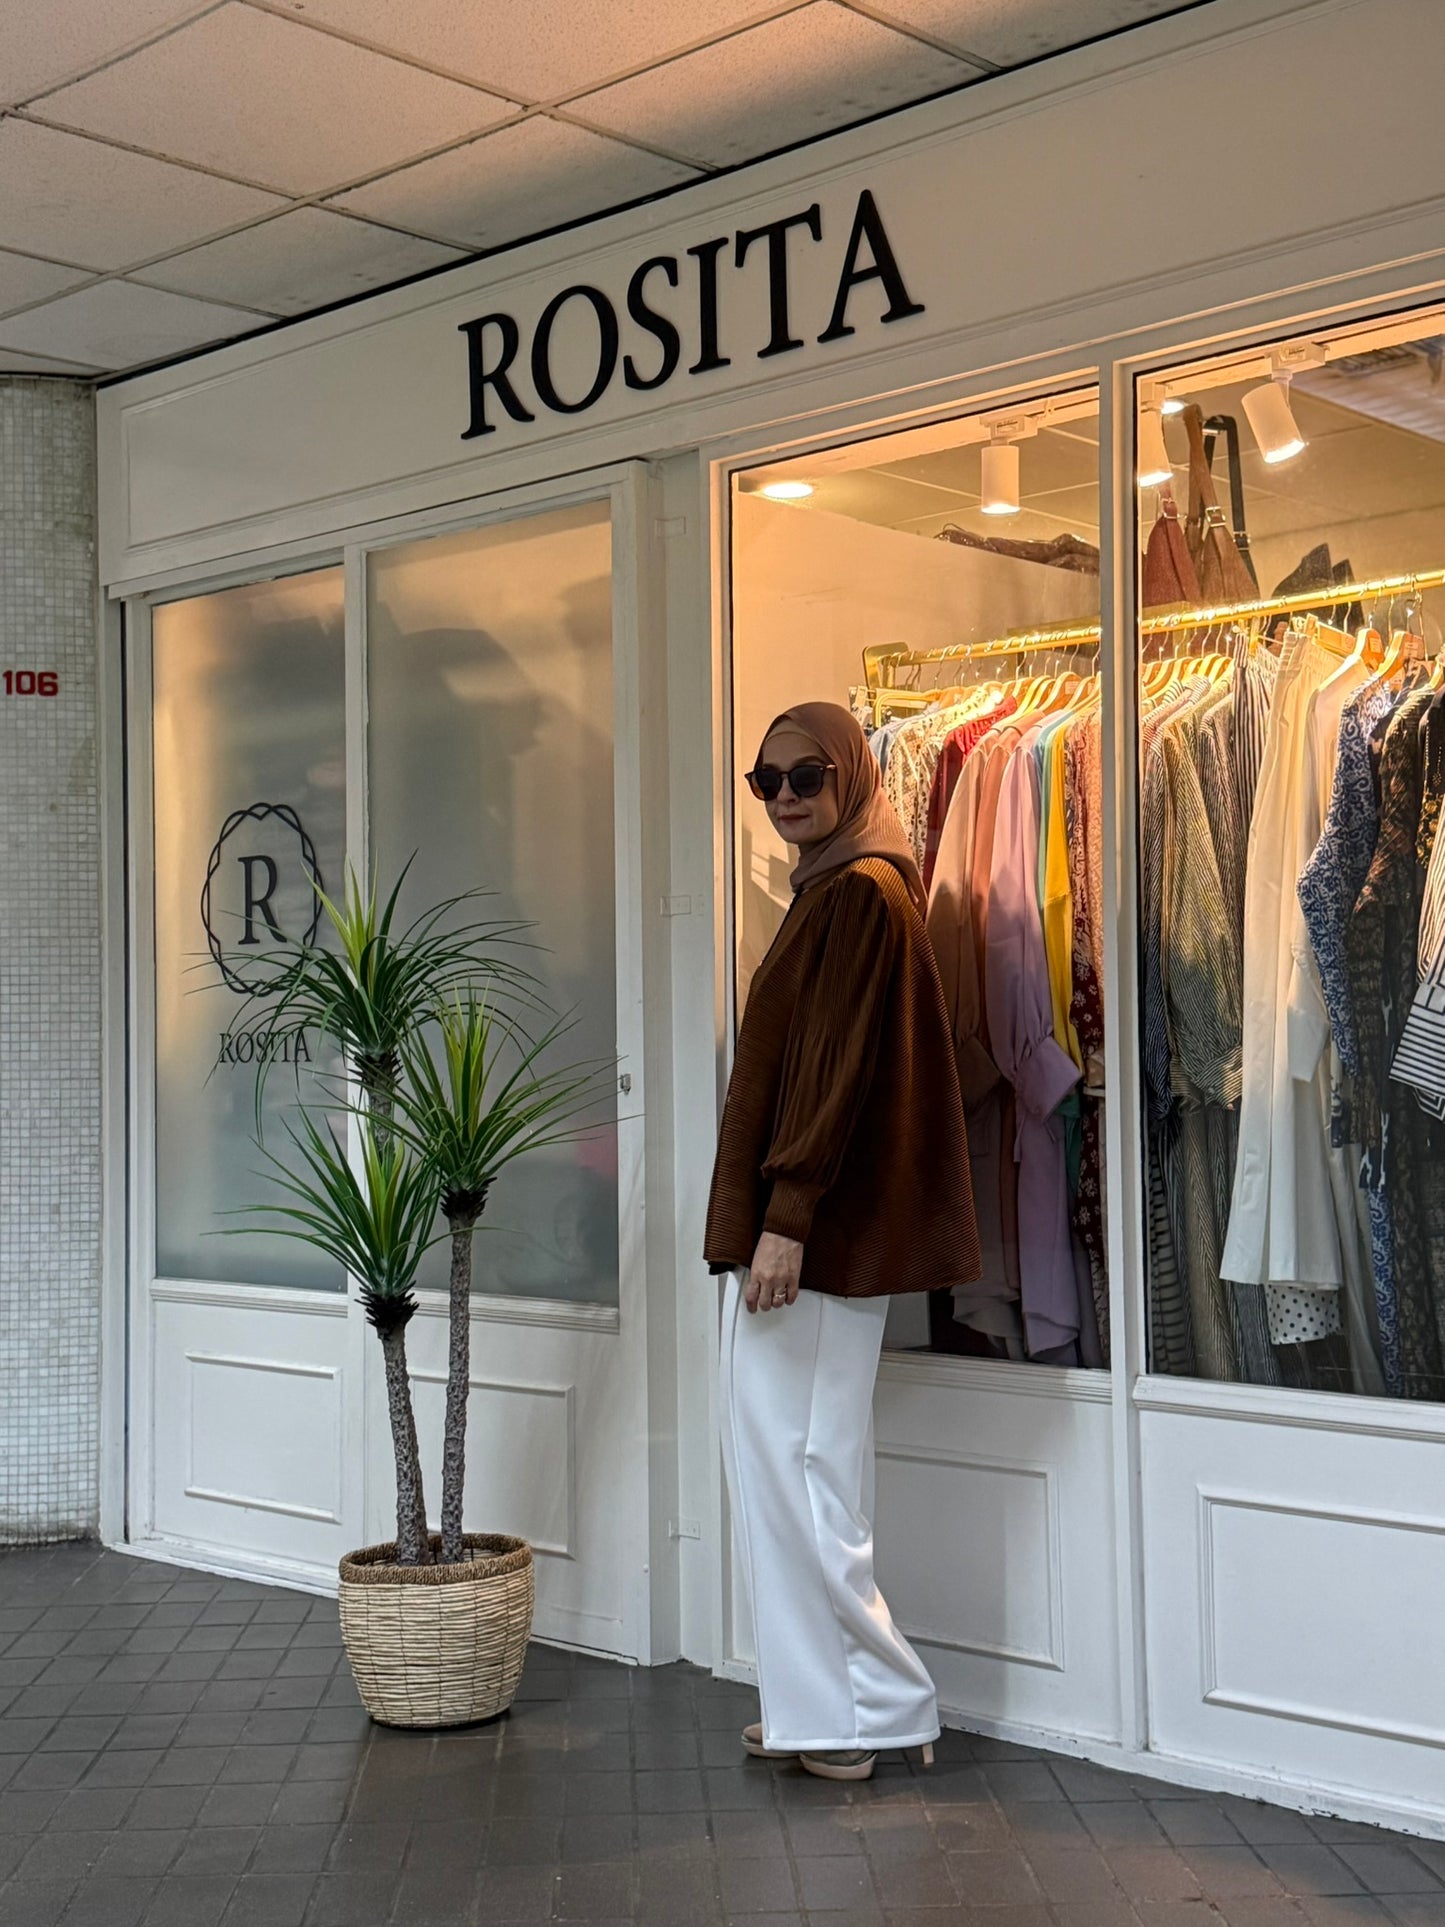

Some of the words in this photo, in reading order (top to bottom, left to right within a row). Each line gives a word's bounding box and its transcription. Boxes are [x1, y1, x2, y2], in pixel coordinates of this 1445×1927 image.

[457, 189, 925, 440] ROSITA
[2, 670, 58, 696] 106
[237, 855, 287, 945] R
